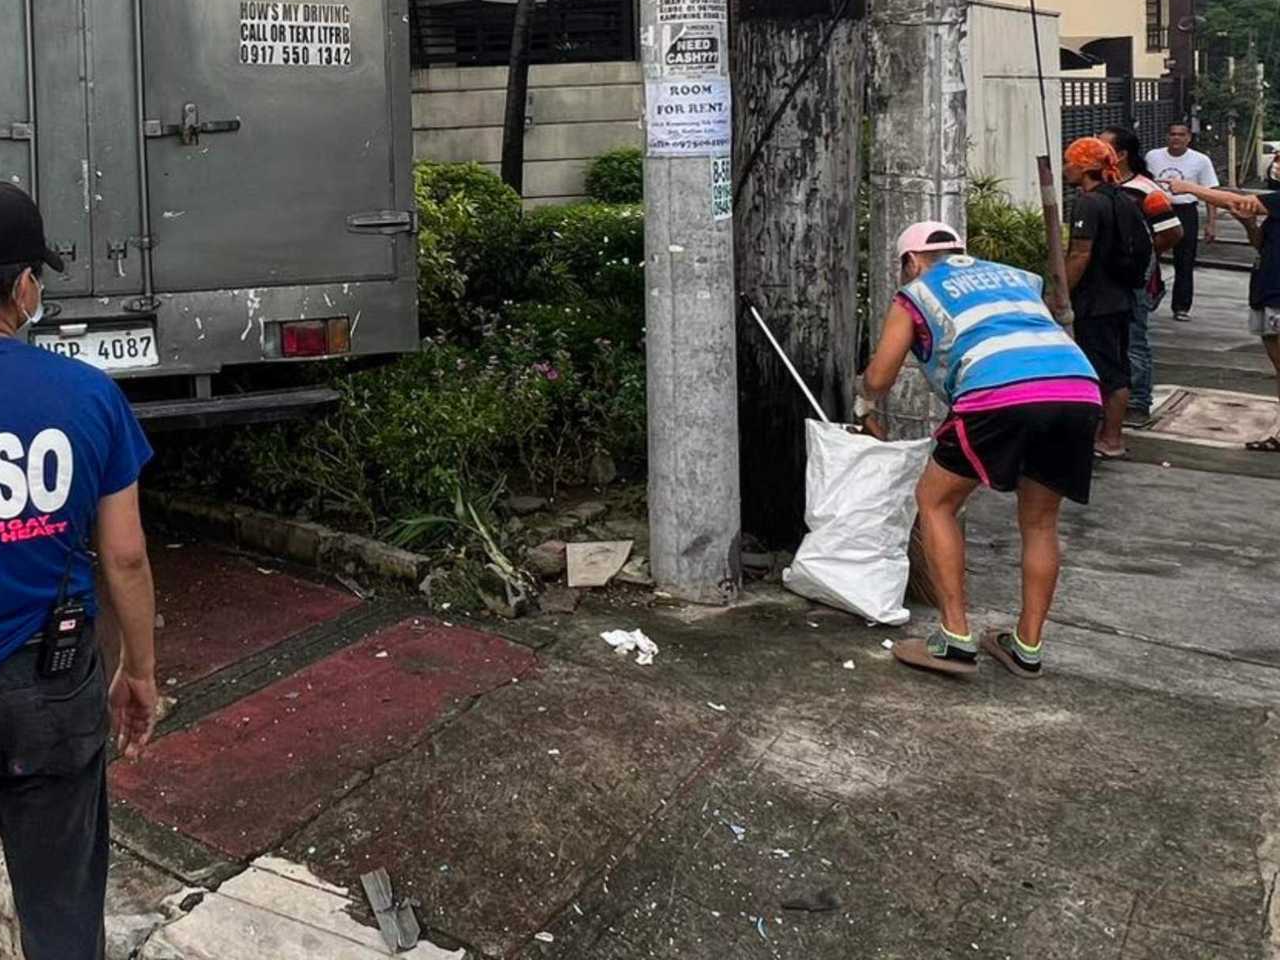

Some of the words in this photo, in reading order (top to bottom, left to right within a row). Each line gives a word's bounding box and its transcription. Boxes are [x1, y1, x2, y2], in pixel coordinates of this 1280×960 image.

[282, 3, 299, 22] MY
[303, 4, 350, 23] DRIVING
[240, 23, 268, 42] CALL
[270, 24, 286, 43] OR
[288, 25, 315, 44] TEXT
[318, 26, 350, 44] LTFRB
[240, 44, 274, 64] 0917
[282, 45, 310, 65] 550
[318, 46, 350, 65] 1342
[676, 39, 712, 52] NEED
[670, 84, 713, 97] ROOM
[657, 104, 685, 115] FOR
[98, 335, 152, 360] 4087
[1, 521, 68, 543] HEART
